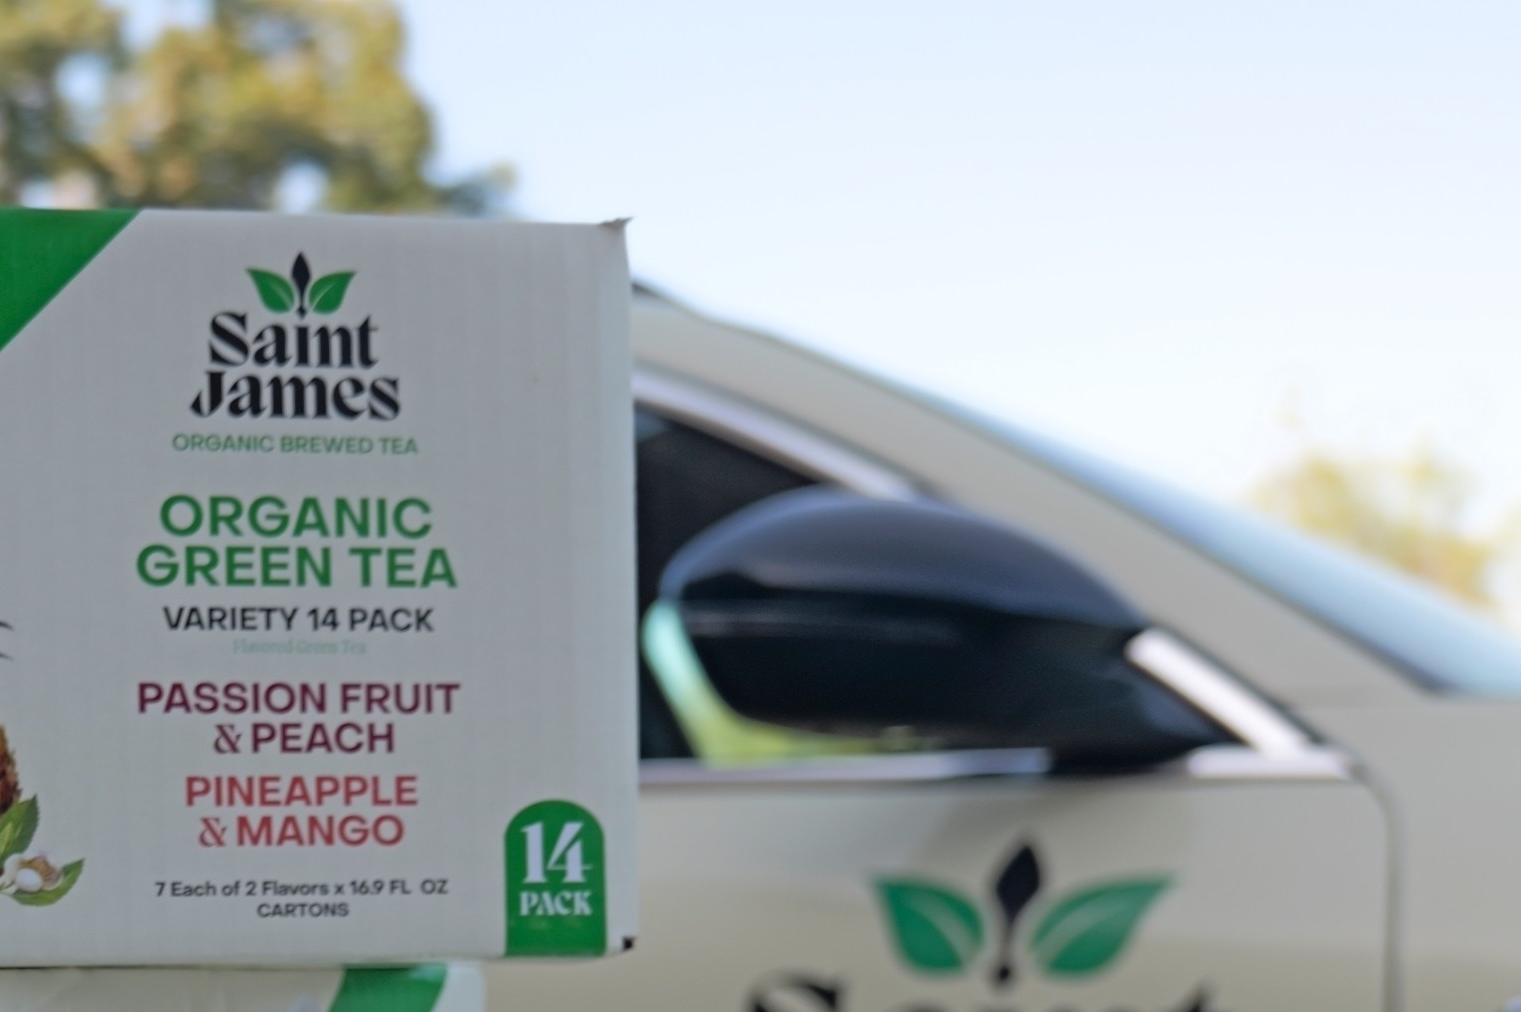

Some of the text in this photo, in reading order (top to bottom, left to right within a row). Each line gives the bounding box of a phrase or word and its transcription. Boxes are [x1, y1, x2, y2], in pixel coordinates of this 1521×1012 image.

[208, 311, 380, 369] Saint
[189, 371, 401, 421] James
[172, 434, 418, 454] ORGANIC BREWED TEA
[160, 494, 433, 540] ORGANIC
[136, 544, 458, 590] GREEN TEA
[163, 607, 434, 632] VARIETY 14 PACK
[138, 682, 461, 715] PASSION FRUIT
[213, 722, 394, 754] & PEACH
[186, 775, 418, 807] PINEAPPLE
[198, 815, 404, 848] & MANGO
[521, 820, 591, 884] 14
[155, 881, 448, 897] 7 Each of 2 Flavors x 16.9 FL OZ
[520, 892, 592, 916] PACK
[258, 903, 349, 918] CARTONS
